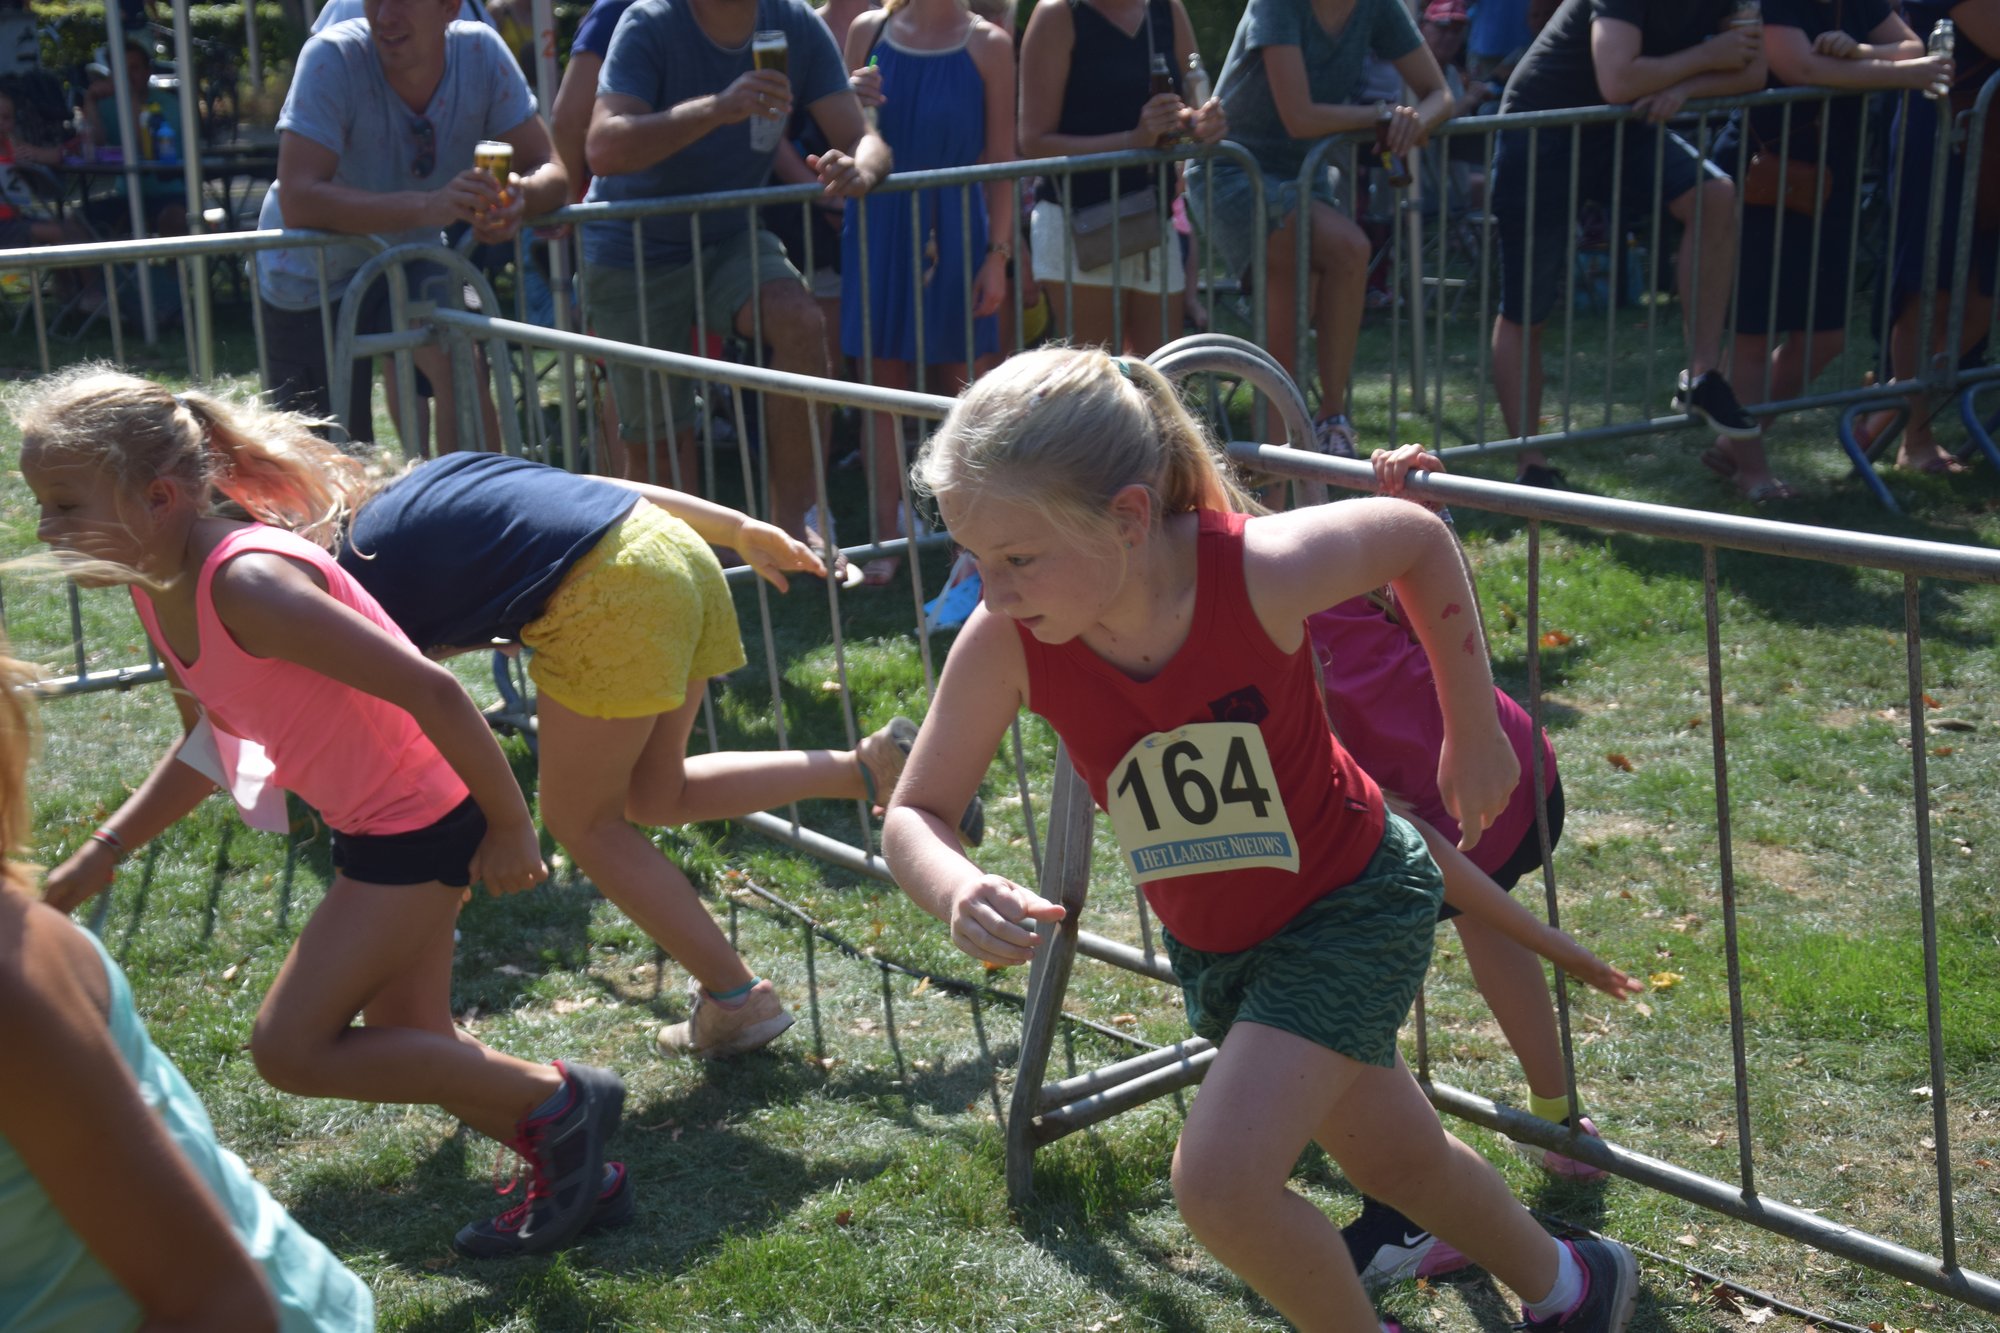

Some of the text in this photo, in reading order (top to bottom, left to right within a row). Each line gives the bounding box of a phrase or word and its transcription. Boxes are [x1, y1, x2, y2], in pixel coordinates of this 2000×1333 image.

[1117, 736, 1272, 831] 164
[1139, 836, 1284, 869] HET LAATSTE NIEUWS
